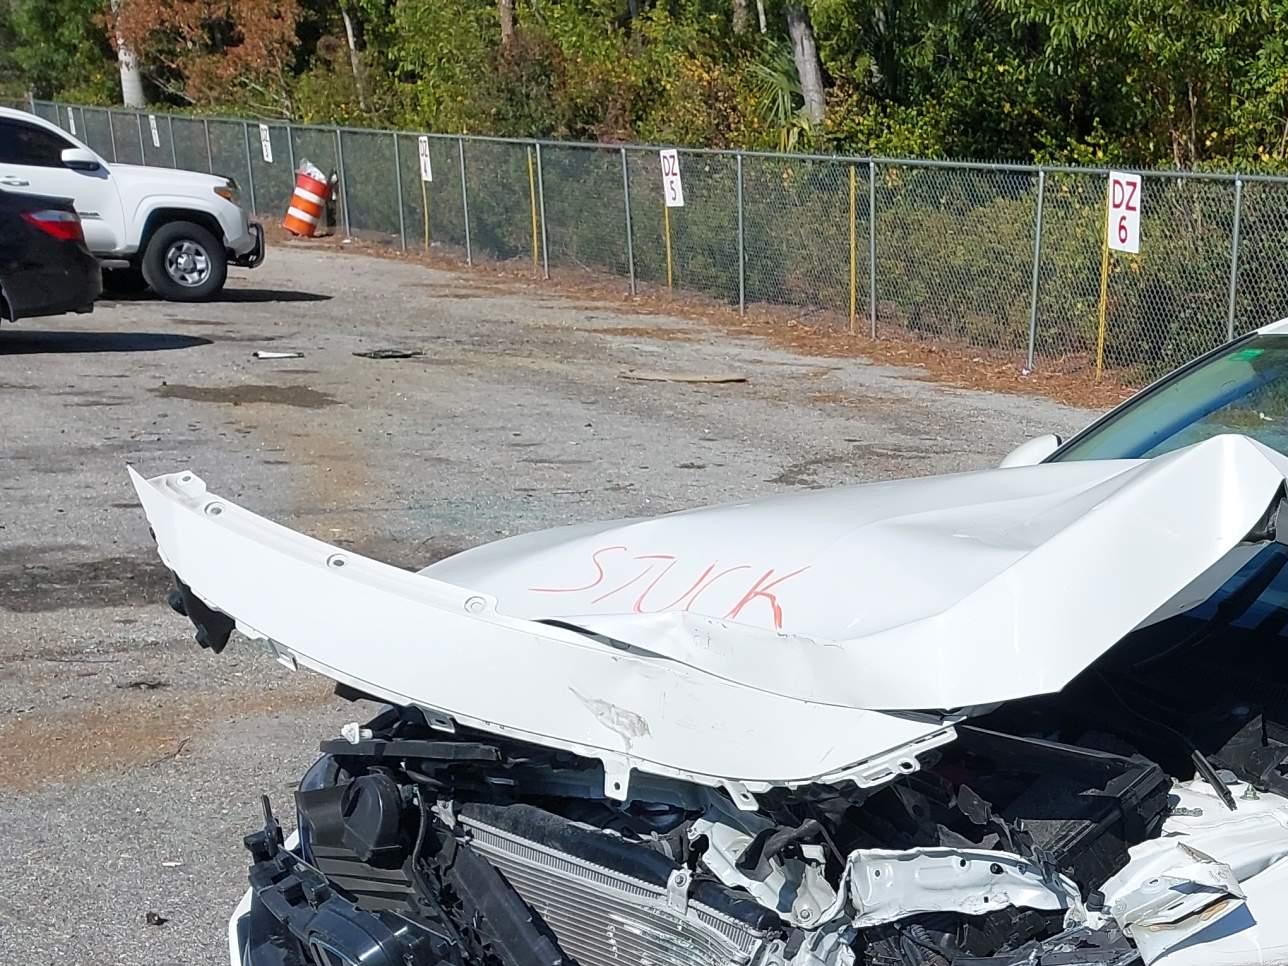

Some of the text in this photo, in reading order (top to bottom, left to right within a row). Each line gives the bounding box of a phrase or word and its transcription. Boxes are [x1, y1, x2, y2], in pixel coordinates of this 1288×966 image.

[662, 154, 678, 177] DZ
[669, 180, 677, 201] 5
[1112, 179, 1137, 212] DZ
[1118, 215, 1128, 244] 6
